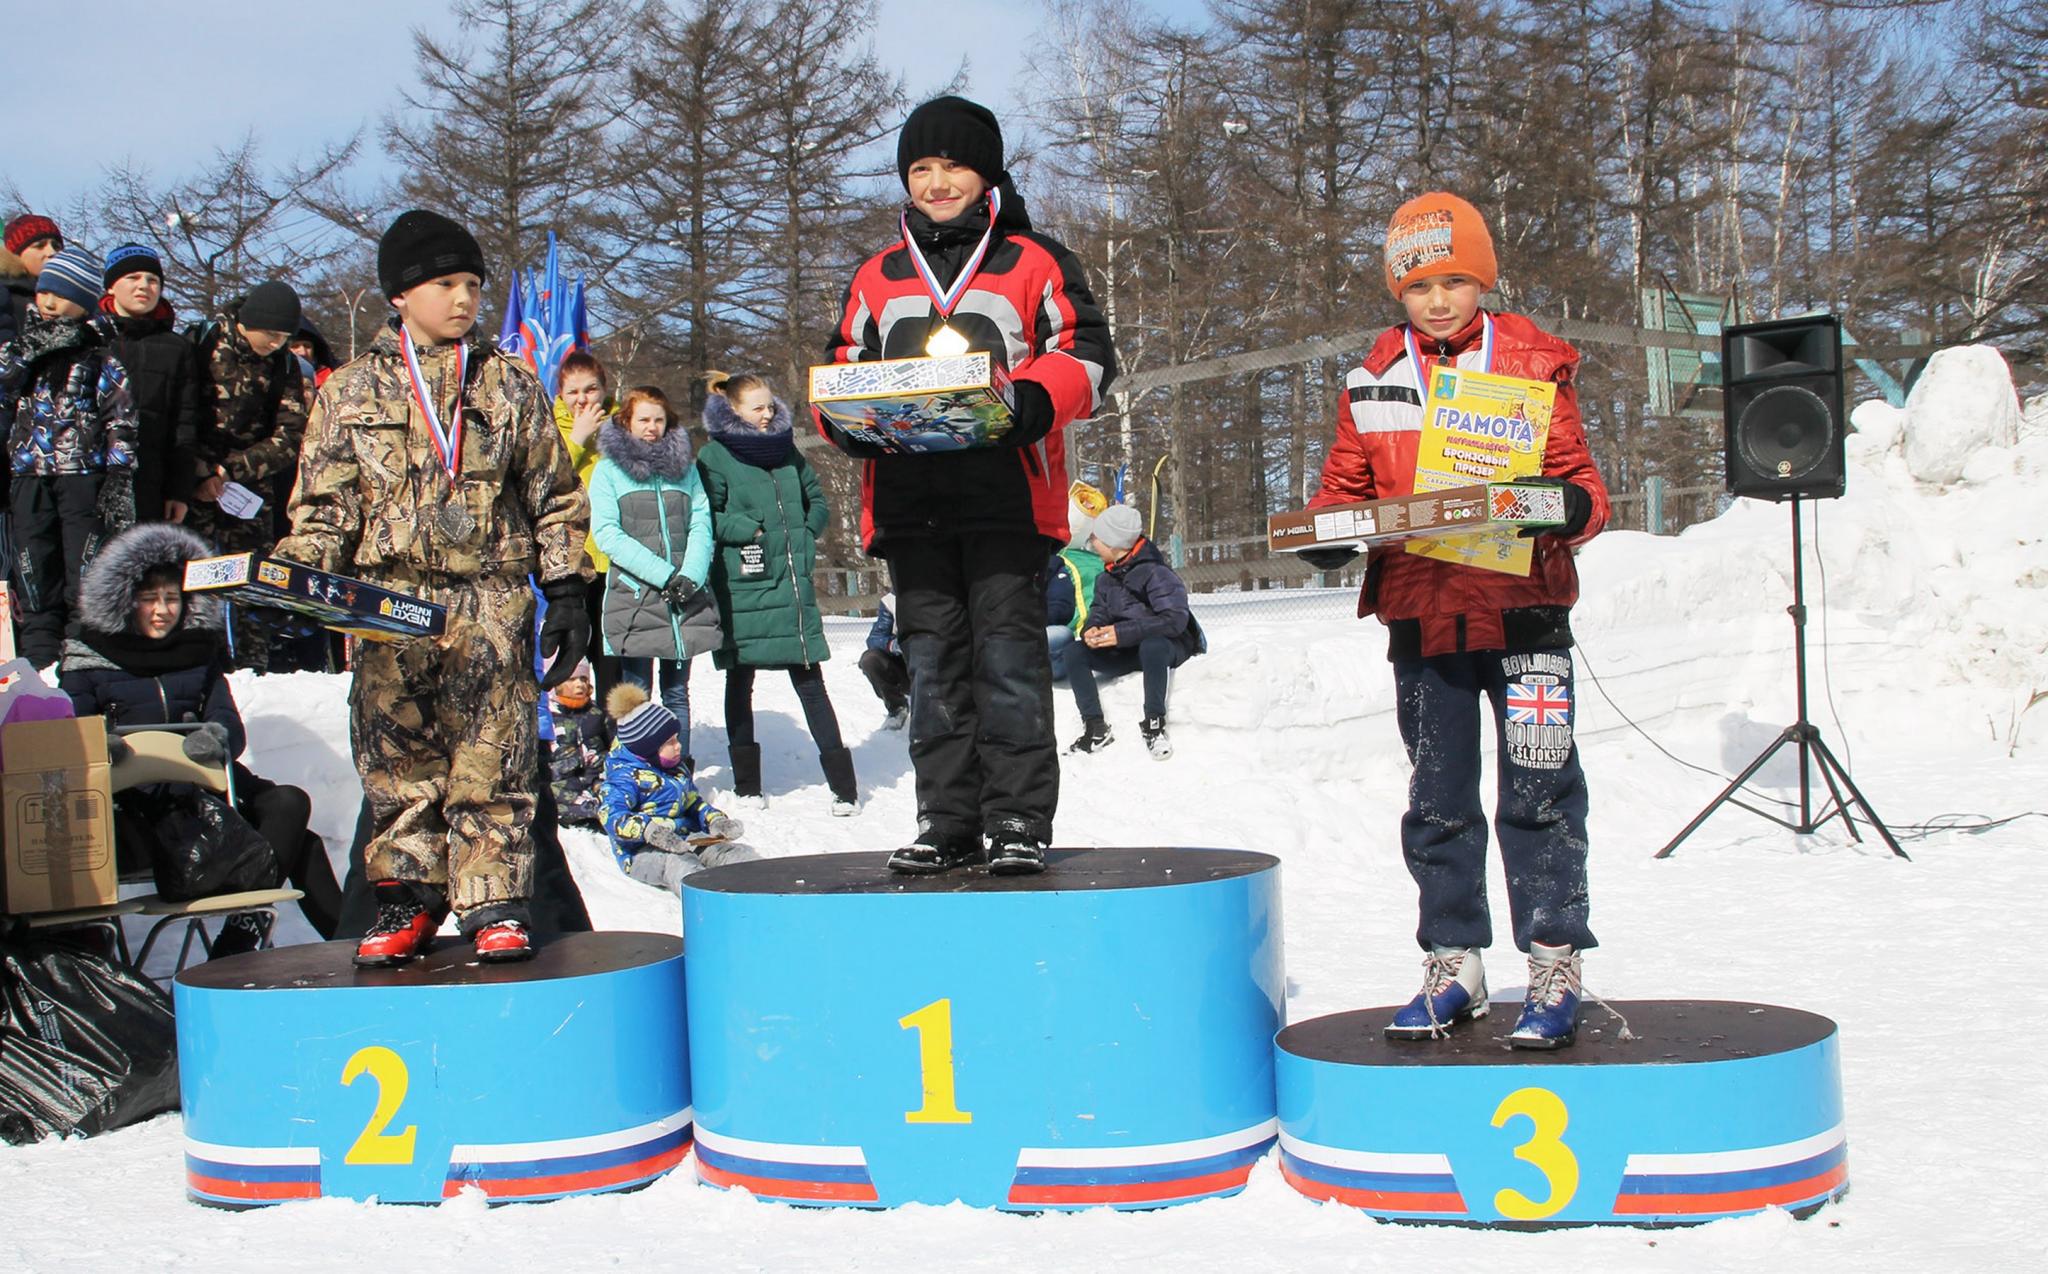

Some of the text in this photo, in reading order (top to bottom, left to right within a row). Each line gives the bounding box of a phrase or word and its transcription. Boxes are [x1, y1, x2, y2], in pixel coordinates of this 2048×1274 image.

[1435, 407, 1533, 443] ГРАМОТА
[1443, 447, 1510, 468] БРОНЗОВЫЙ
[1453, 462, 1495, 477] ПРИЗЕР
[392, 607, 431, 628] NEXO
[394, 600, 432, 617] KNIGHT
[898, 998, 973, 1123] 1
[340, 1045, 418, 1165] 2
[1490, 1086, 1580, 1221] 3
